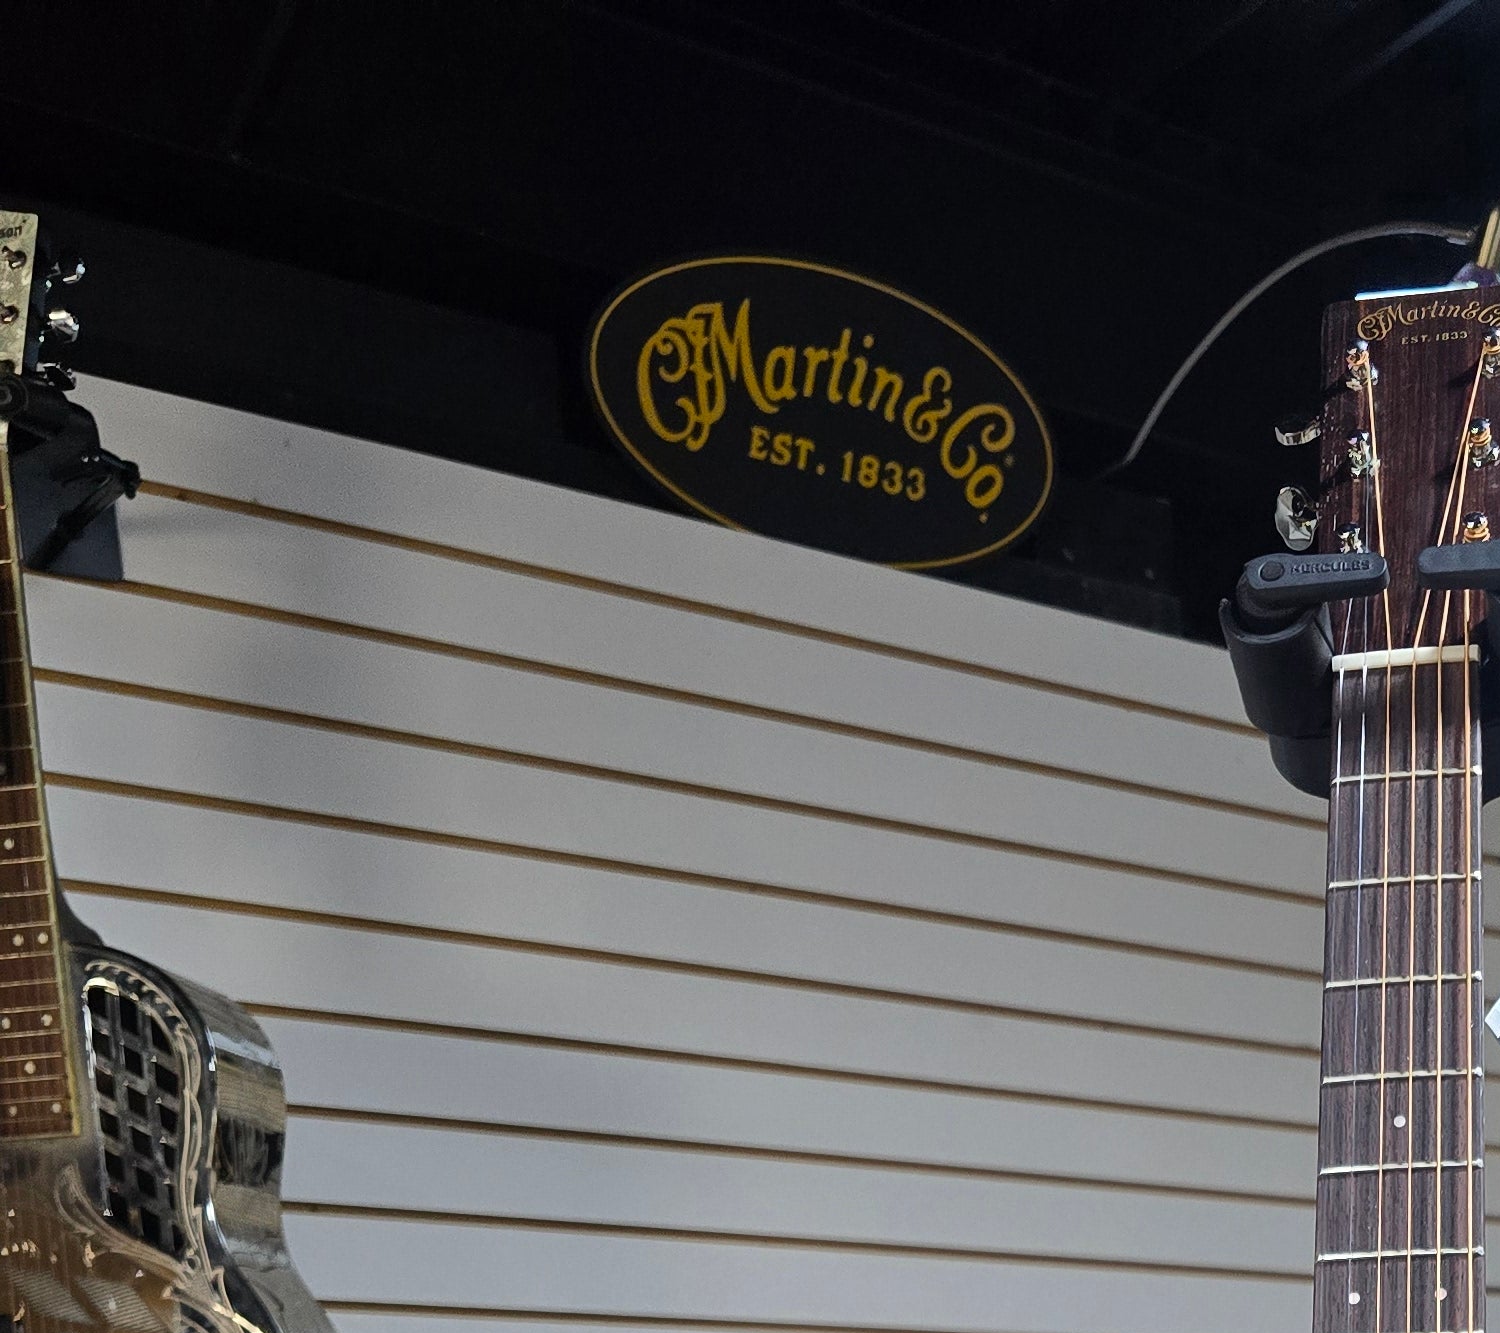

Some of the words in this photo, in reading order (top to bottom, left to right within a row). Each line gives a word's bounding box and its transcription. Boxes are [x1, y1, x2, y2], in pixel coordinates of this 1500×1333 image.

[1435, 330, 1468, 342] 1833
[748, 425, 827, 477] EST.
[841, 451, 926, 501] 1833
